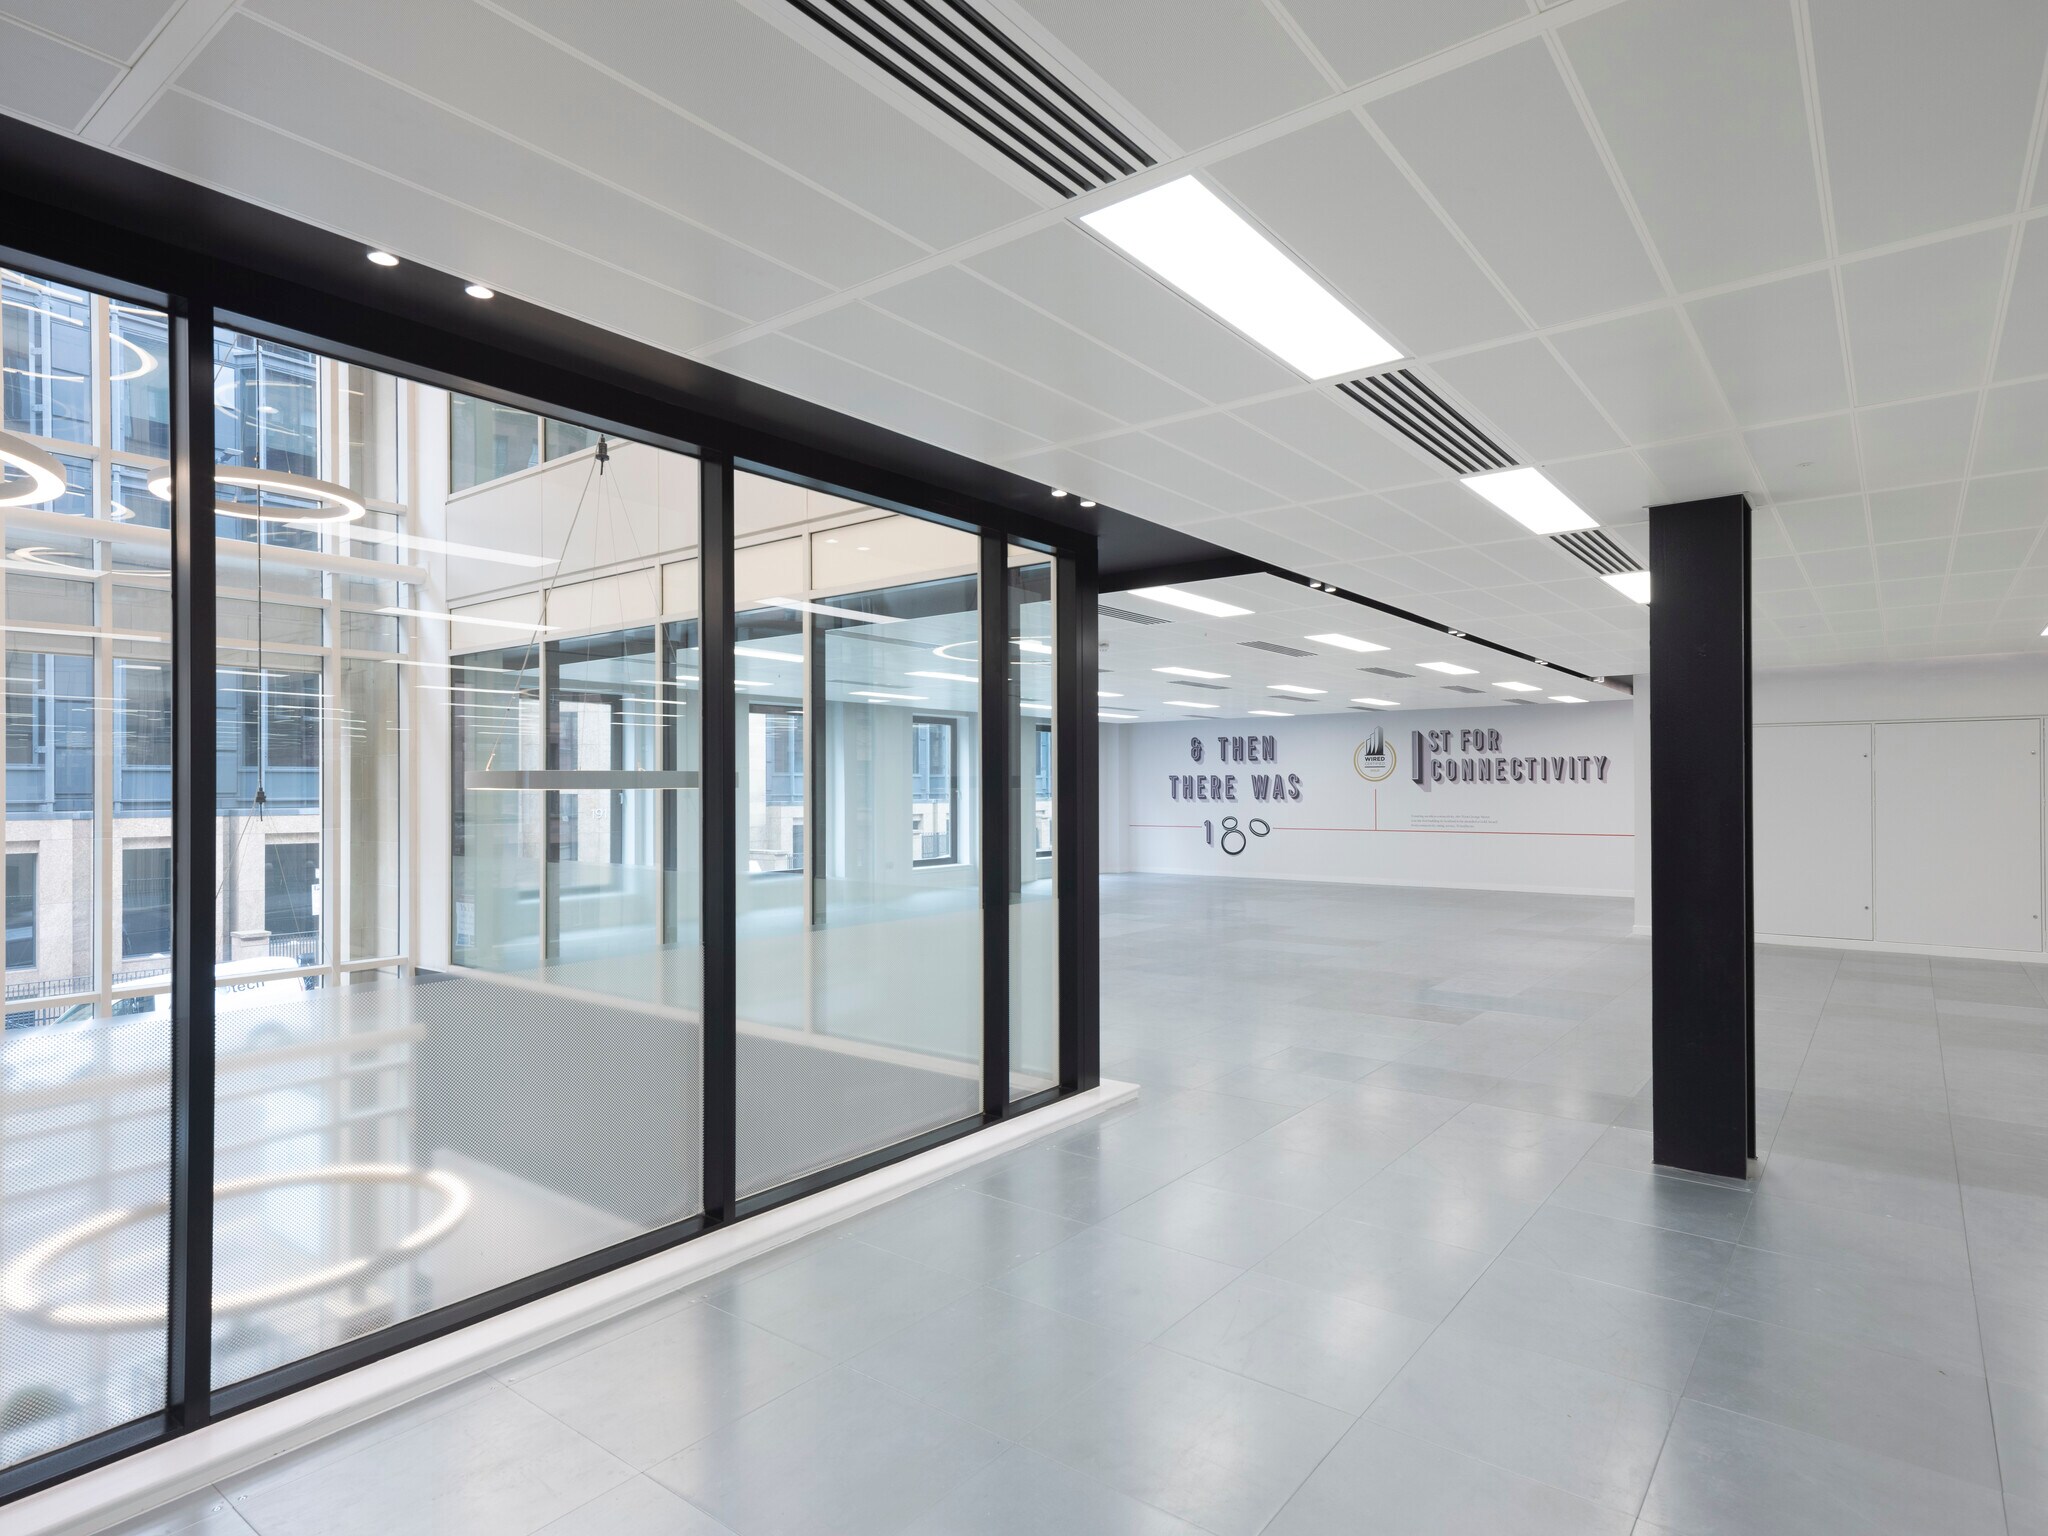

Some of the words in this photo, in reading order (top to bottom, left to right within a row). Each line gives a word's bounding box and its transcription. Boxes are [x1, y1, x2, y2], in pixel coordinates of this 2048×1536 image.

[1190, 736, 1203, 763] &
[1218, 735, 1276, 763] THEN
[1460, 728, 1501, 753] FOR
[1430, 755, 1611, 784] CONNECTIVITY
[1168, 774, 1238, 802] THERE
[1250, 773, 1302, 802] WAS
[1203, 815, 1271, 856] 180
